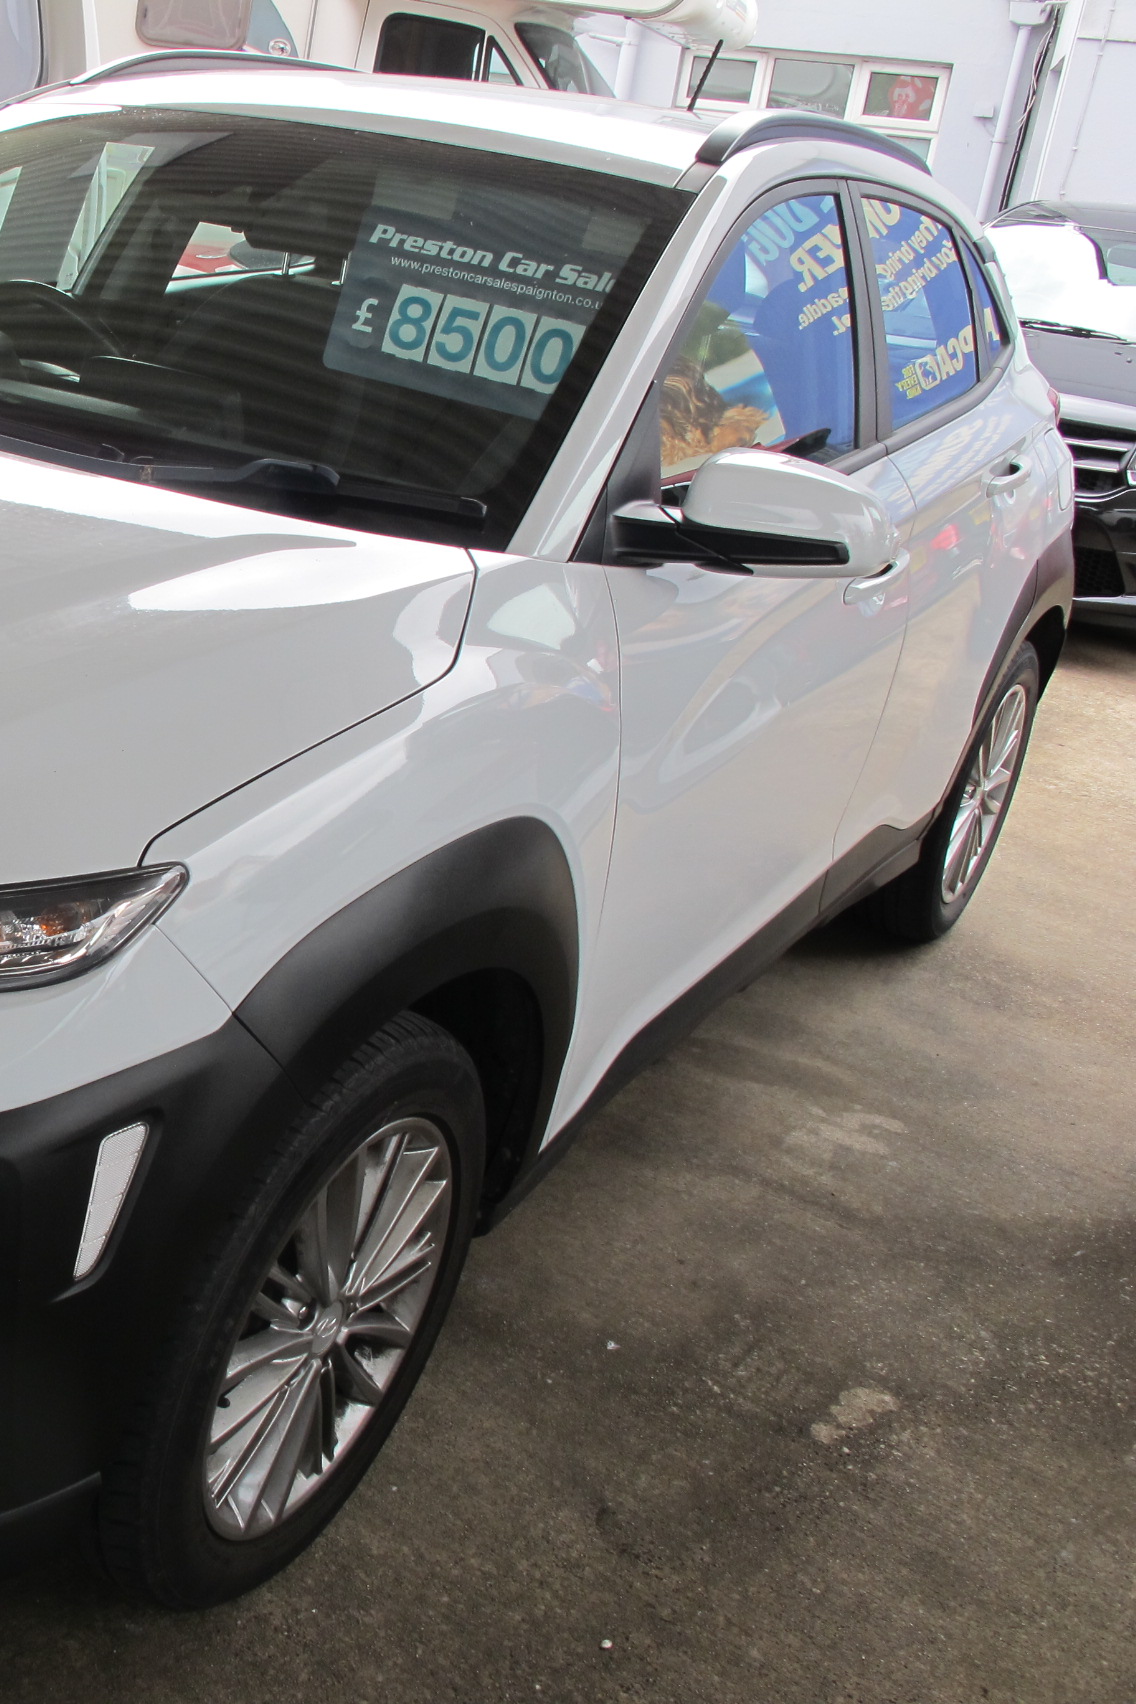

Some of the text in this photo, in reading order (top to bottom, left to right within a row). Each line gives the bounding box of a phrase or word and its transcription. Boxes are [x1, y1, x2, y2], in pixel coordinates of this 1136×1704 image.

[368, 223, 494, 268] Preston
[497, 251, 554, 279] Car
[387, 295, 575, 385] 8500
